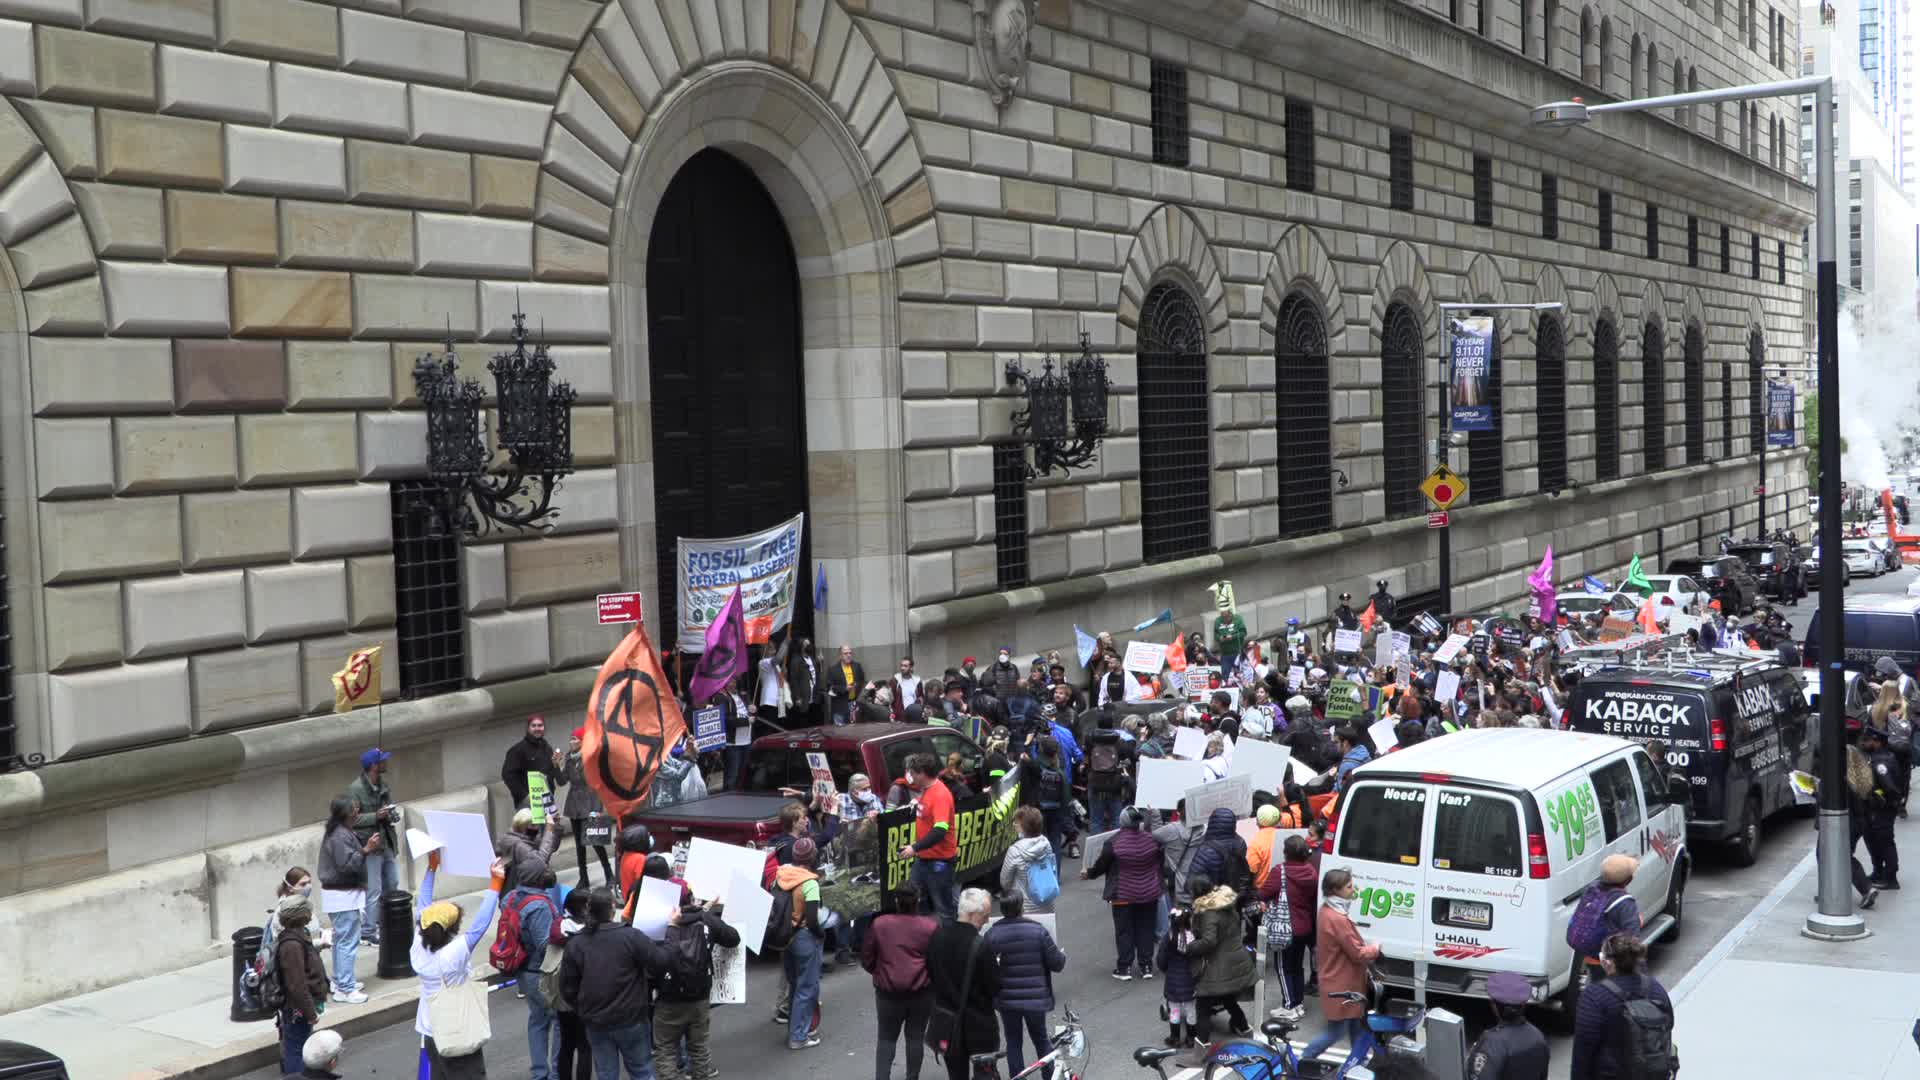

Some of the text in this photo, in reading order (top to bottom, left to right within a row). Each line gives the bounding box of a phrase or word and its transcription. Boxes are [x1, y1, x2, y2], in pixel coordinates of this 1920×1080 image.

[1465, 338, 1484, 346] YEARS
[1456, 346, 1484, 357] 9.11.01
[1456, 357, 1484, 368] NEVER
[1456, 367, 1484, 377] FORGET
[687, 529, 797, 574] FOSSIL FREE
[687, 552, 796, 589] FEDERAL RESERVE
[608, 595, 634, 604] STOPPING
[1331, 686, 1349, 695] Off
[1330, 694, 1354, 703] Foss
[1604, 691, 1674, 702] INFO@KABACK.COM
[1733, 682, 1773, 719] KABACK
[1328, 702, 1354, 712] Fuels
[1585, 698, 1692, 726] KABACK
[698, 723, 721, 734] CLIMATE
[1603, 721, 1671, 736] SERVICE
[1675, 739, 1701, 748] HEATING
[1691, 775, 1708, 786] 199
[1383, 787, 1426, 802] Need a
[1440, 792, 1471, 806] Van?
[1485, 866, 1496, 875] BE
[1496, 868, 1511, 876] 1142
[1435, 932, 1481, 946] U-HAUL
